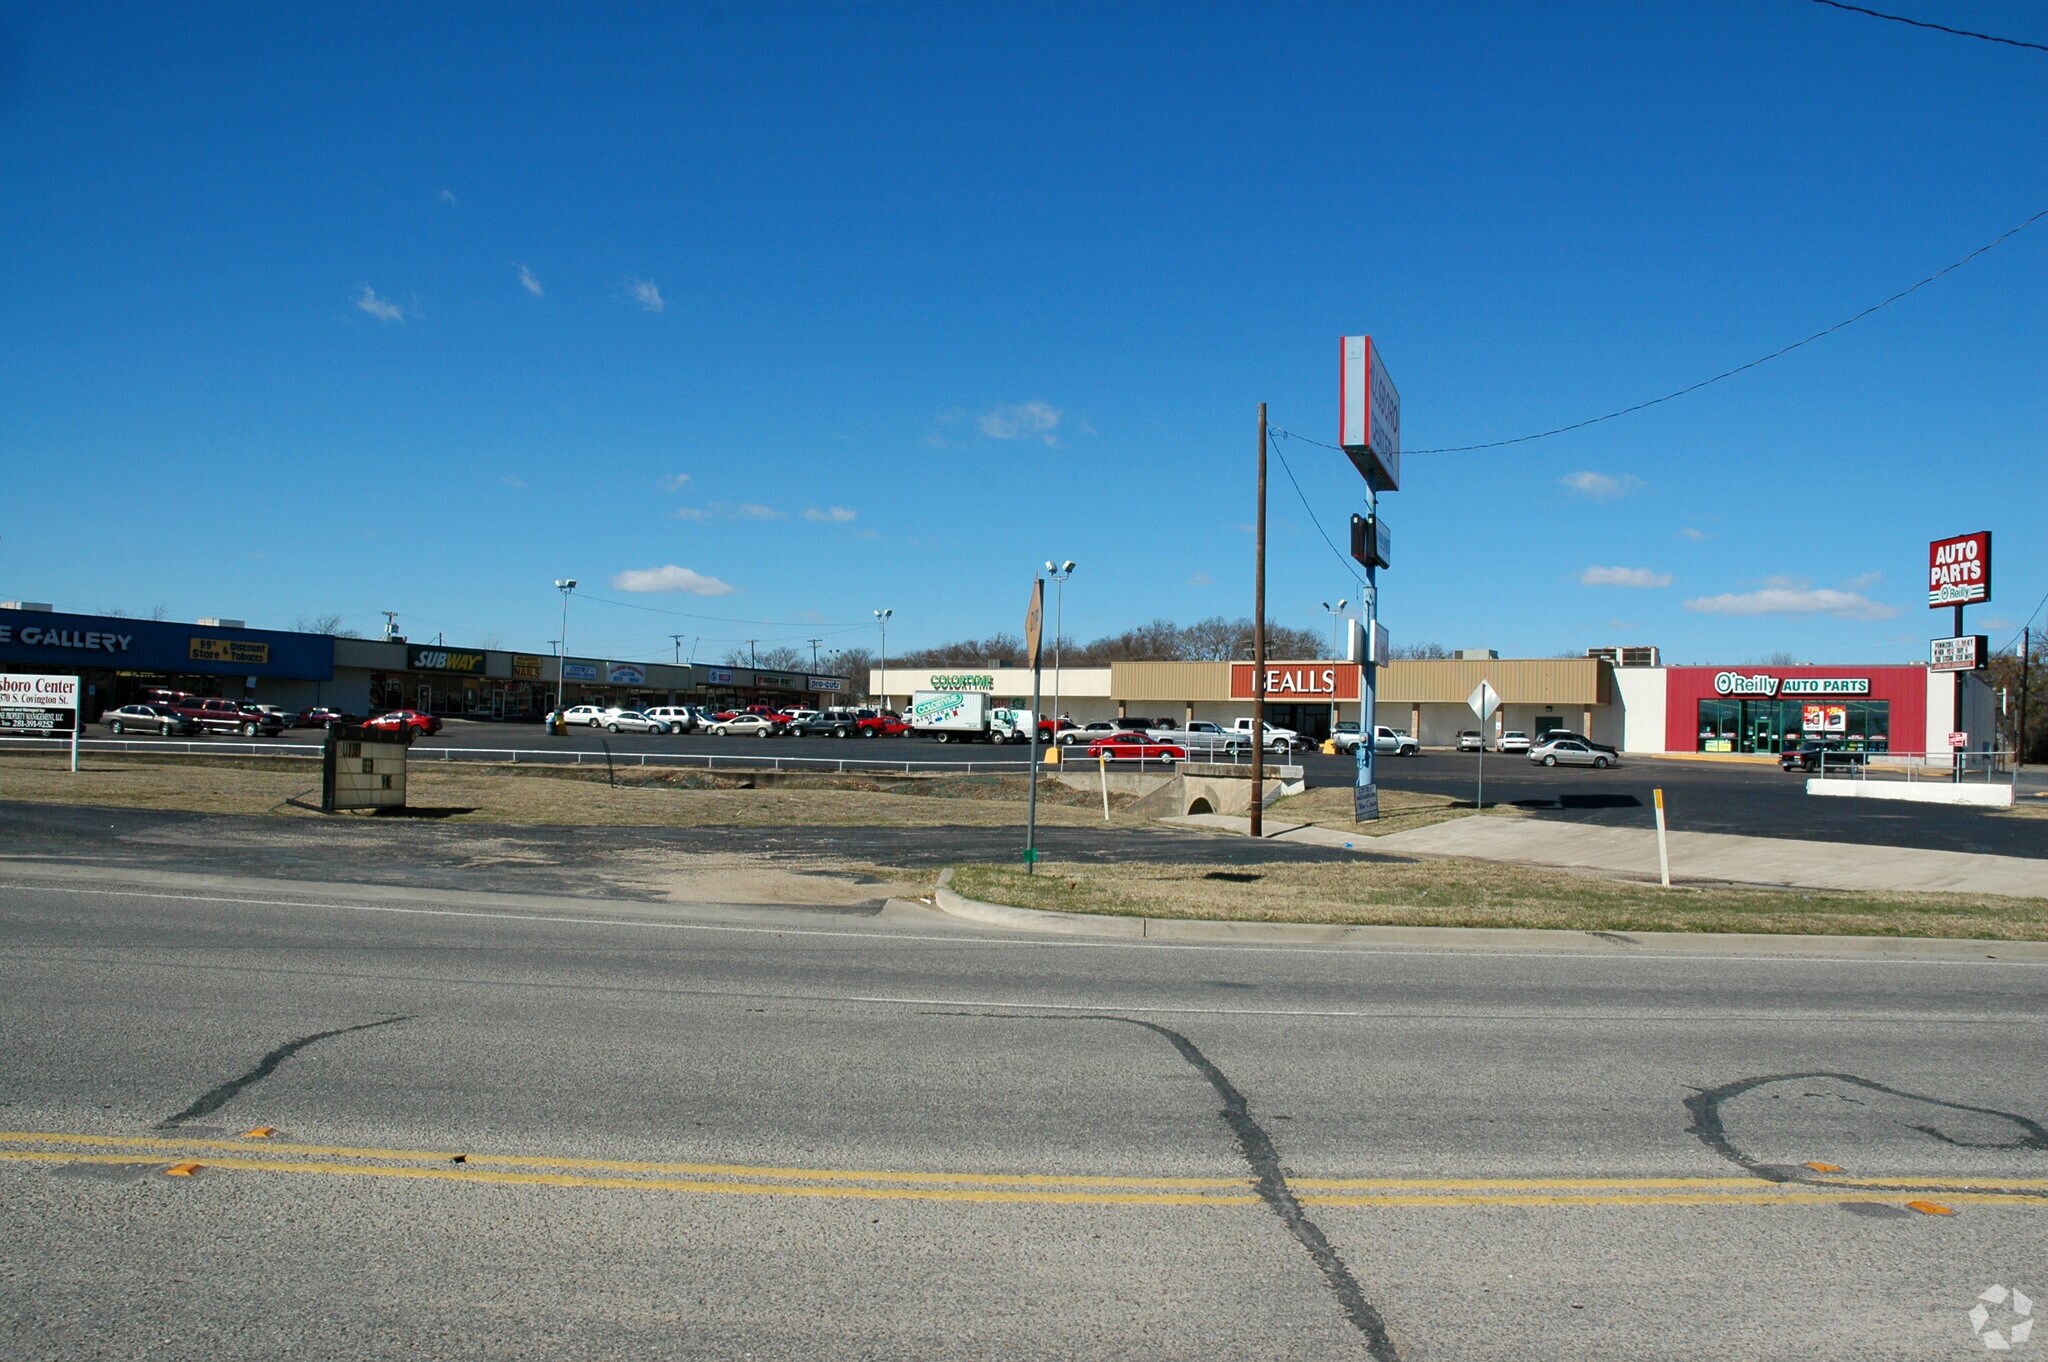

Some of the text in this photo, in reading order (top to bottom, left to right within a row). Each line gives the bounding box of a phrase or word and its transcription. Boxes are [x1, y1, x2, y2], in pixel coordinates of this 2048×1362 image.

[1935, 540, 1978, 565] AUTO
[1931, 560, 1981, 585] PARTS
[1941, 586, 1970, 601] O'Reilly
[21, 627, 132, 653] GALLERY
[231, 642, 265, 653] Discount
[192, 649, 220, 659] Store
[223, 646, 229, 655] &
[231, 652, 264, 662] Tobacco
[414, 651, 483, 671] SUBWAY
[513, 667, 540, 678] NAILS
[36, 678, 75, 693] Center
[930, 675, 993, 689] COLORTYME
[1716, 673, 1867, 694] O'Reilly AUTO PARTS
[21, 694, 57, 705] Covington
[59, 695, 68, 704] St.
[917, 692, 960, 714] COLORTYME
